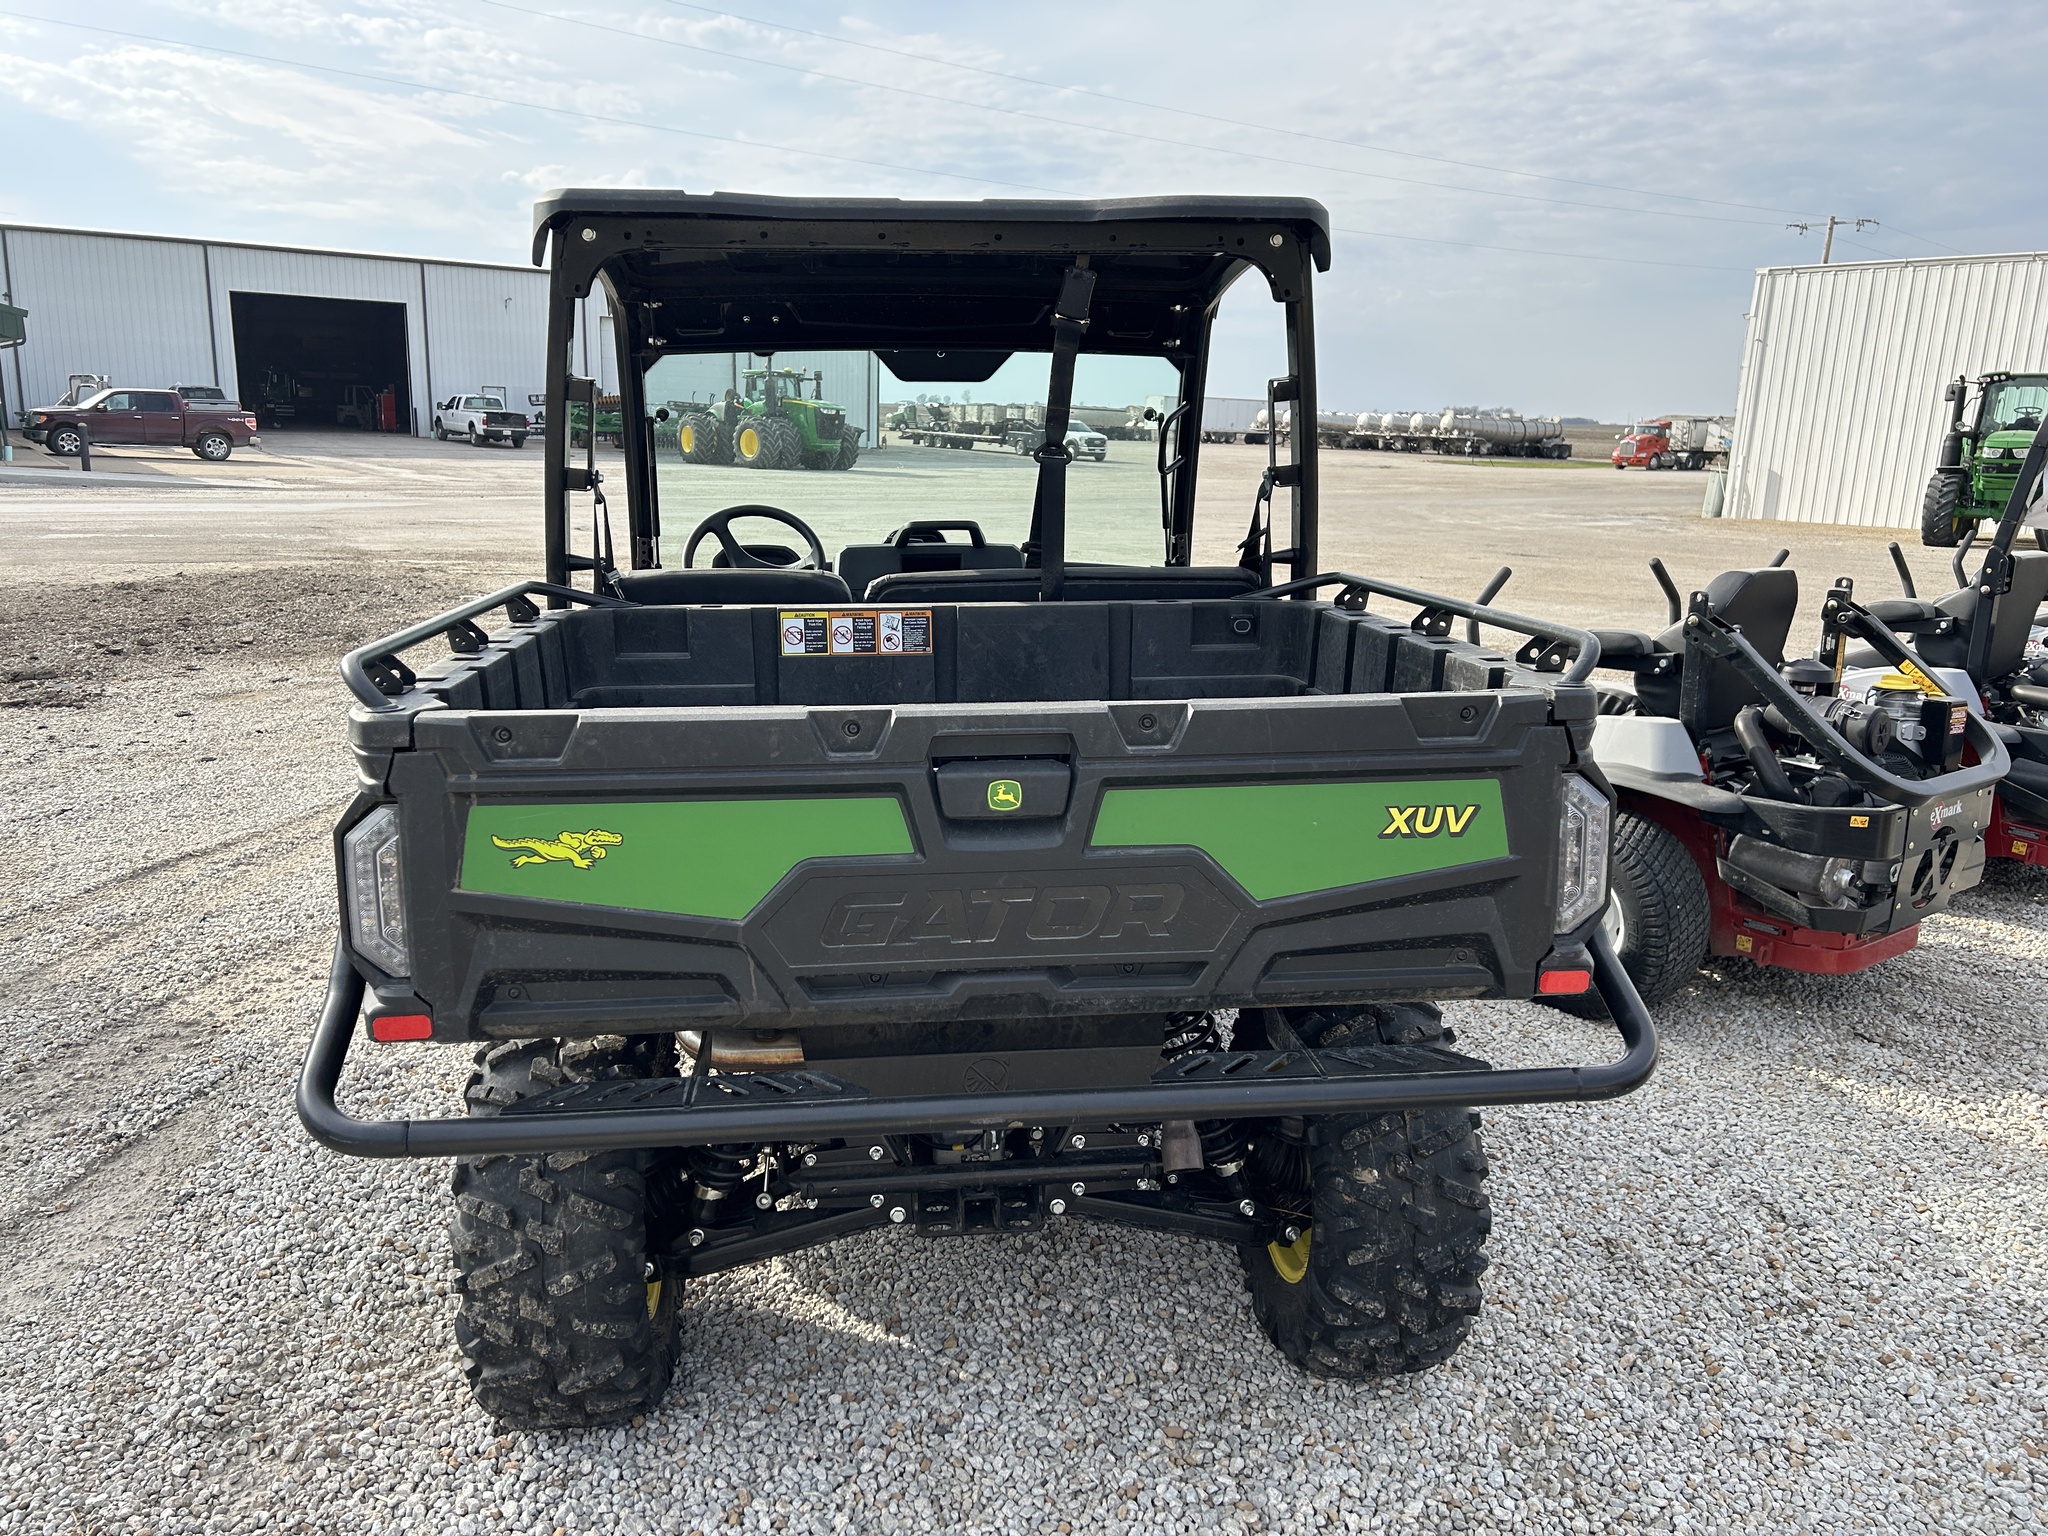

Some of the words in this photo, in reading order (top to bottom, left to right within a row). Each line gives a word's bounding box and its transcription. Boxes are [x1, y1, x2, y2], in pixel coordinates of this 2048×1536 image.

[1377, 804, 1481, 839] XUV
[1931, 800, 1962, 826] eXmark
[820, 883, 1185, 948] GATOR
